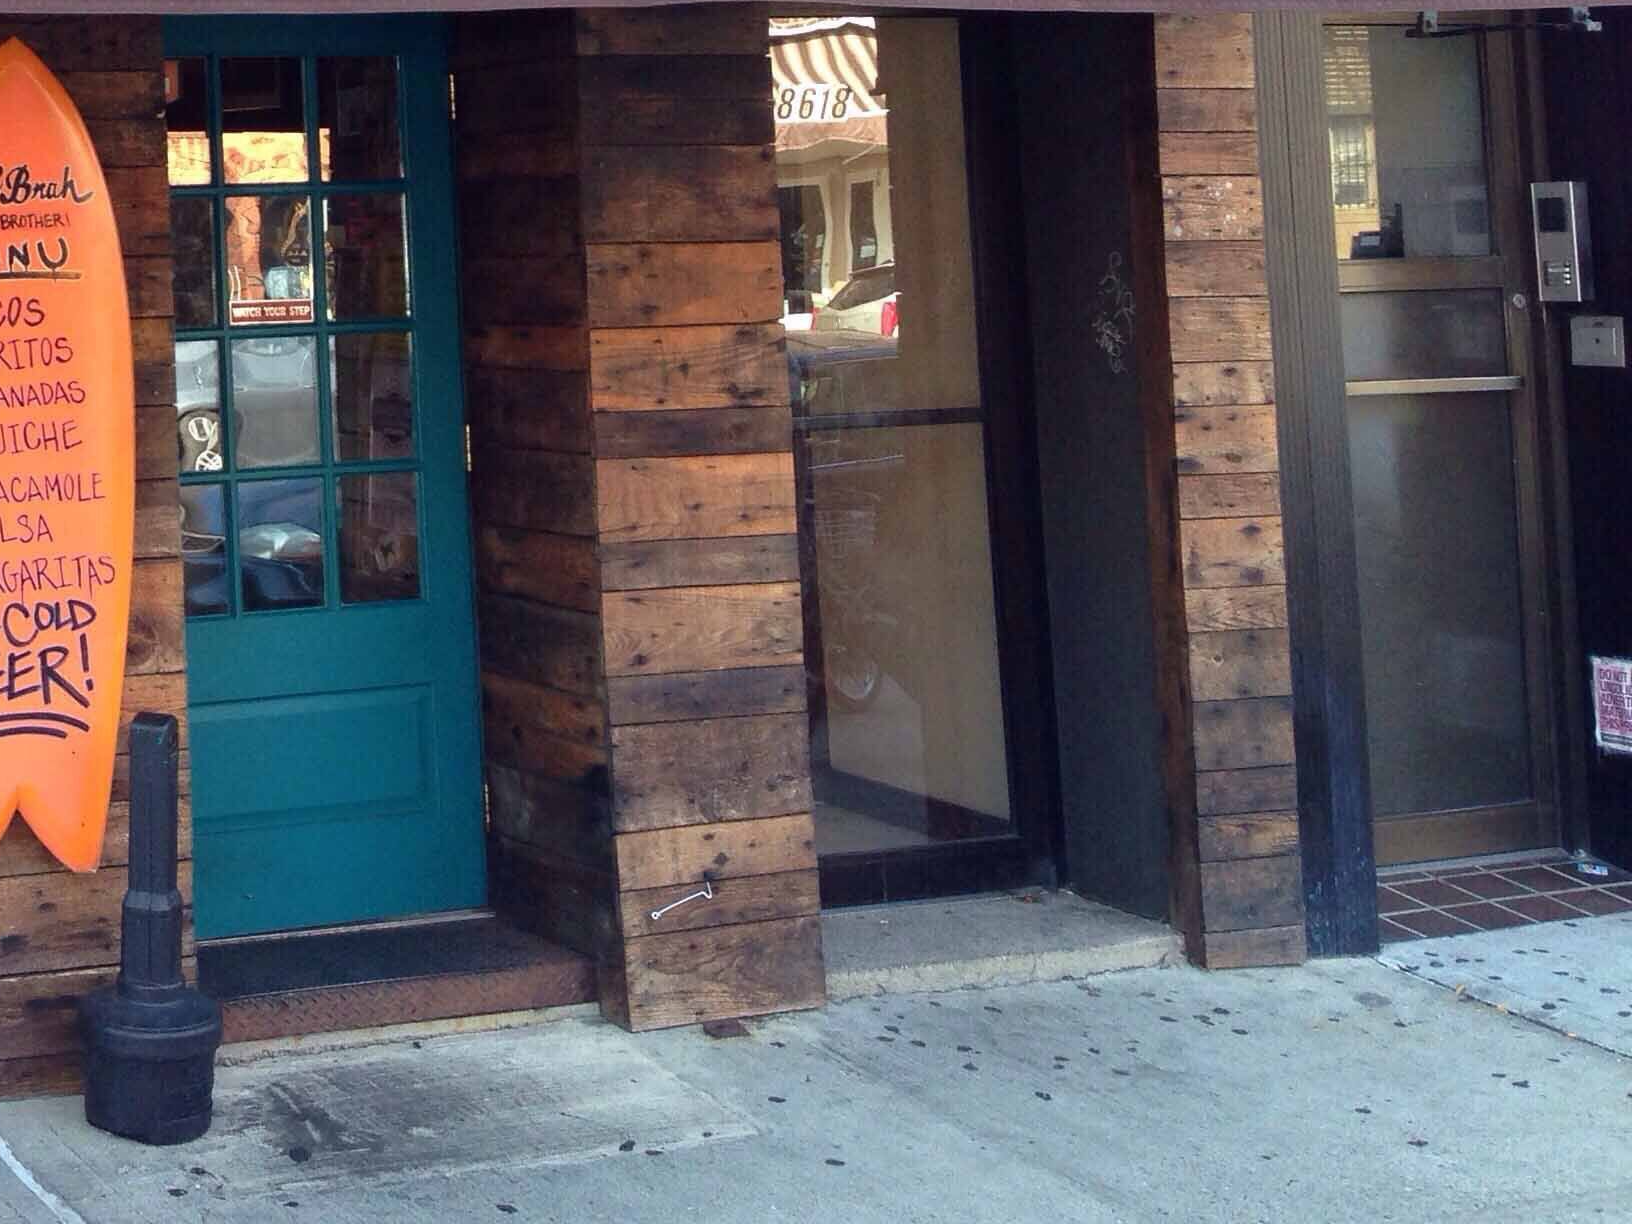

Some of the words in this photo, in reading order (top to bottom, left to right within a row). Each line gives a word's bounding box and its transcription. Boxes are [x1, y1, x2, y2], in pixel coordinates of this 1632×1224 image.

[776, 87, 850, 120] 8618
[232, 306, 261, 318] WATCH
[263, 306, 287, 317] YOUR
[289, 305, 311, 316] STEP
[3, 599, 97, 648] COLD
